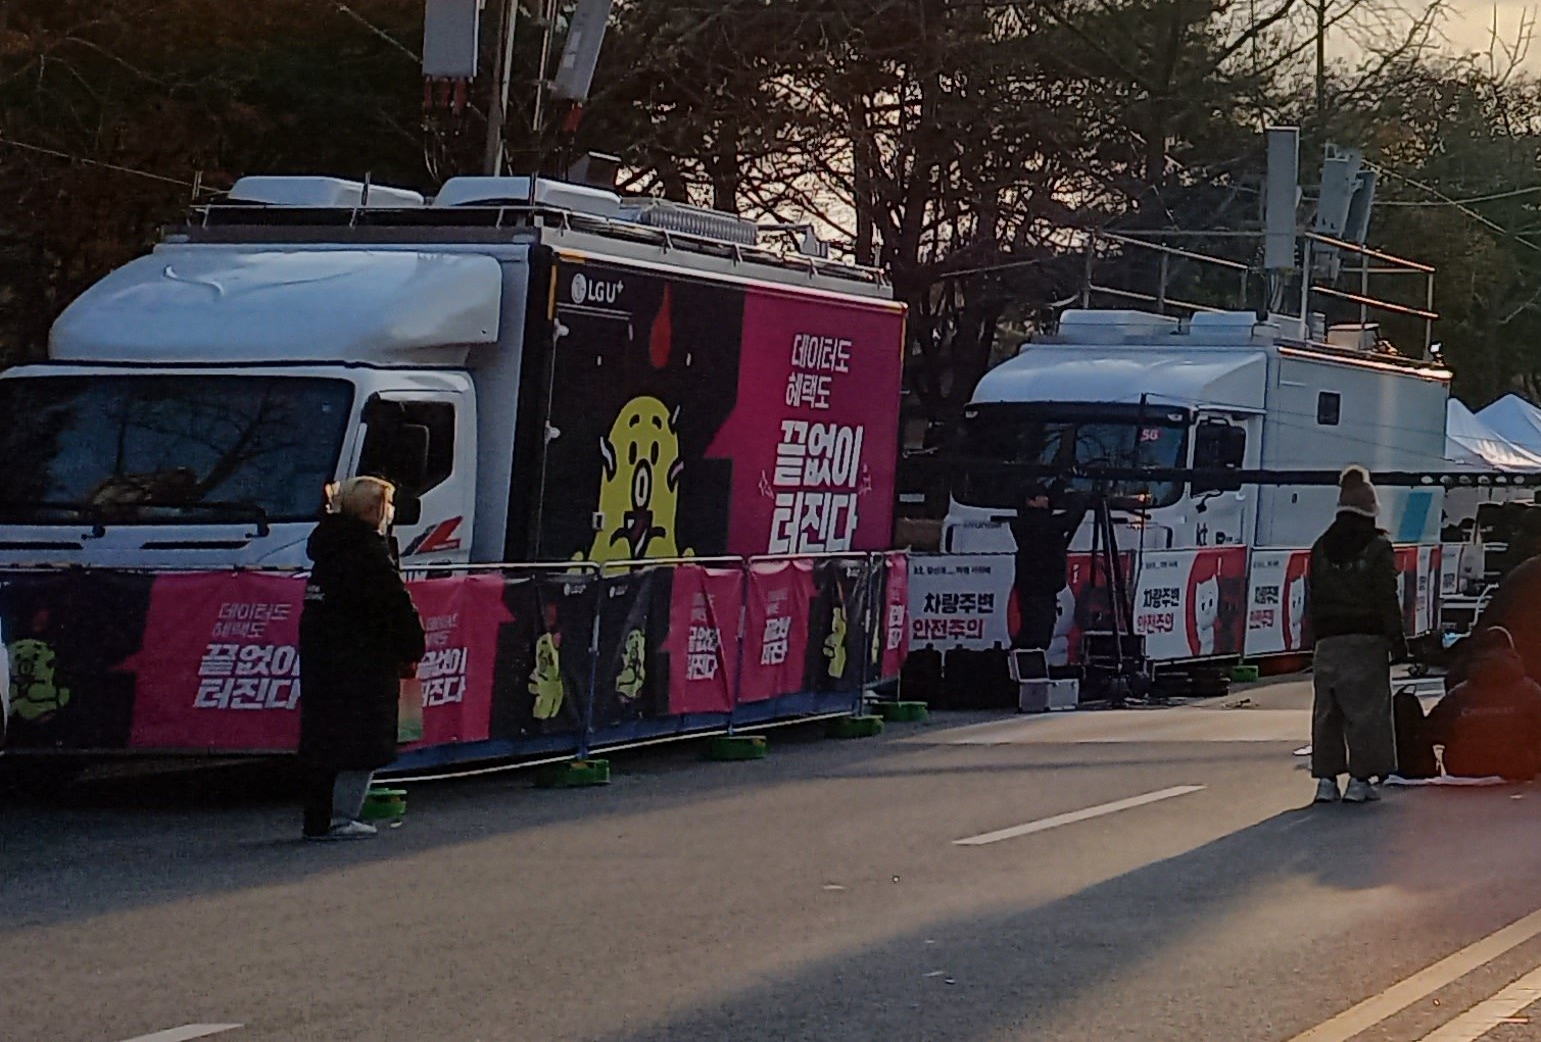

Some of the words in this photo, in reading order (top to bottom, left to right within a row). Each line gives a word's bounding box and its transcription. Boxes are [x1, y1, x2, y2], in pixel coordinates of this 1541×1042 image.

[791, 334, 852, 373] 데이터도
[785, 372, 832, 409] 혜택도
[773, 420, 863, 488] 끝없이
[767, 491, 858, 554] 터진다
[923, 592, 994, 615] 차량주변
[912, 618, 984, 640] 안전주의
[192, 678, 301, 710] 터진다
